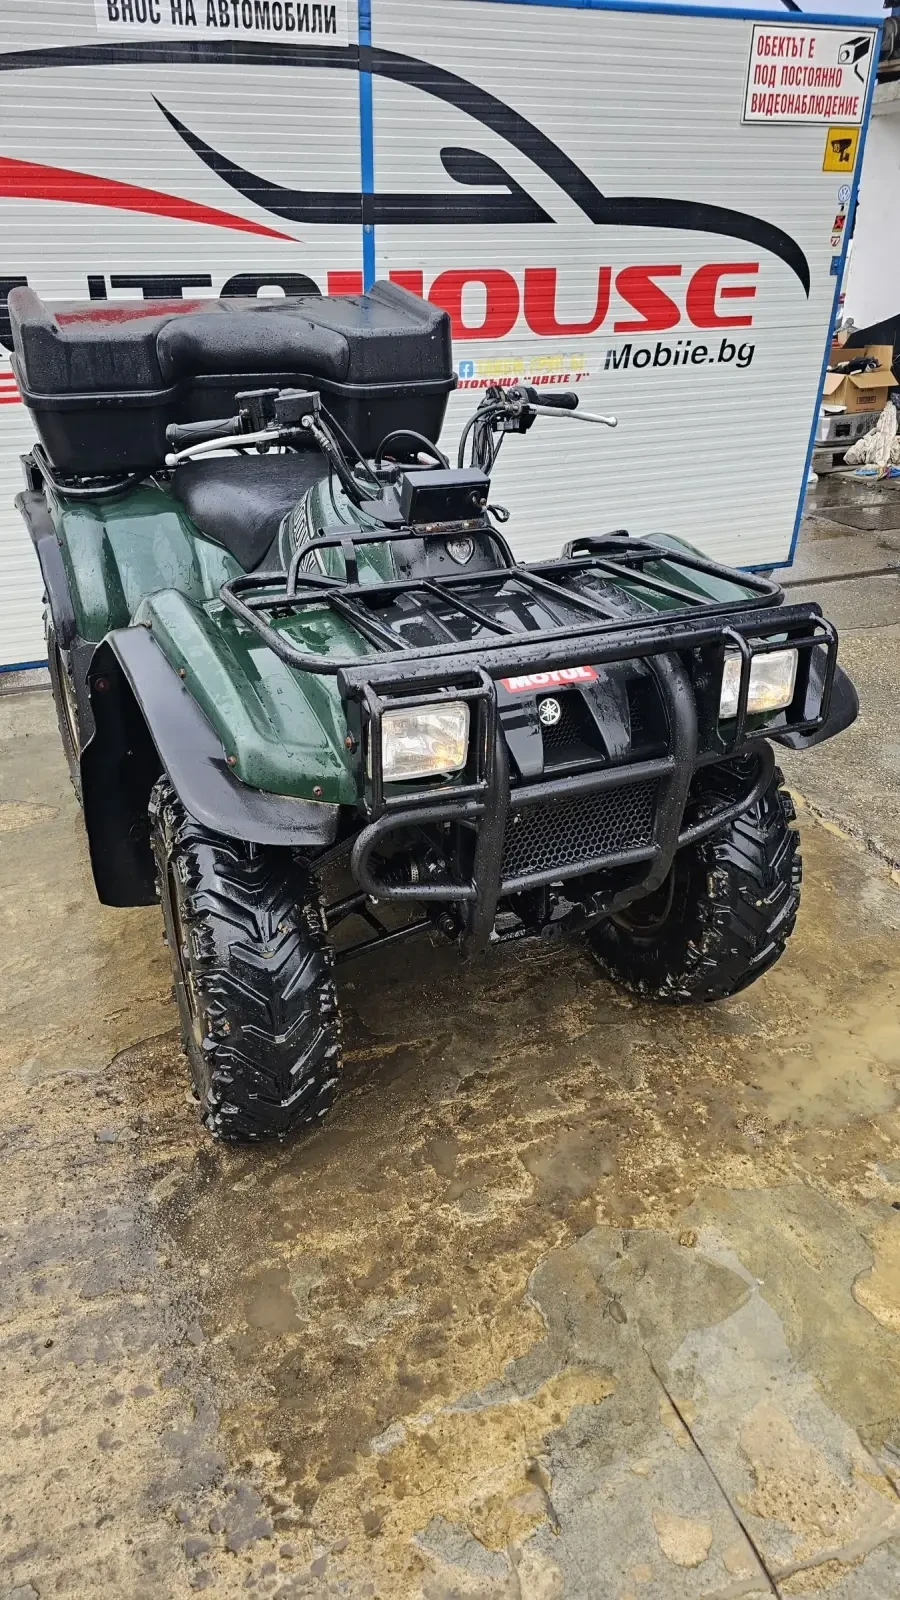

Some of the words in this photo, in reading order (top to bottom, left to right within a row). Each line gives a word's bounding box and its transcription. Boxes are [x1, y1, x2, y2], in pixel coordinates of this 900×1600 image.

[107, 0, 161, 24] ВНОС
[170, 0, 197, 26] НА
[206, 0, 337, 34] АВТОМОБИЛИ
[757, 35, 805, 58] ОБЕКТЪТ
[808, 38, 816, 58] Е
[753, 64, 777, 88] ПОД
[781, 65, 843, 88] ПОСТОЯННО
[751, 93, 859, 117] ВИДЕОНАБЛЮДЕНИЕ
[457, 377, 519, 389] ВТОКЪЩА
[508, 666, 591, 690] MOTUL
